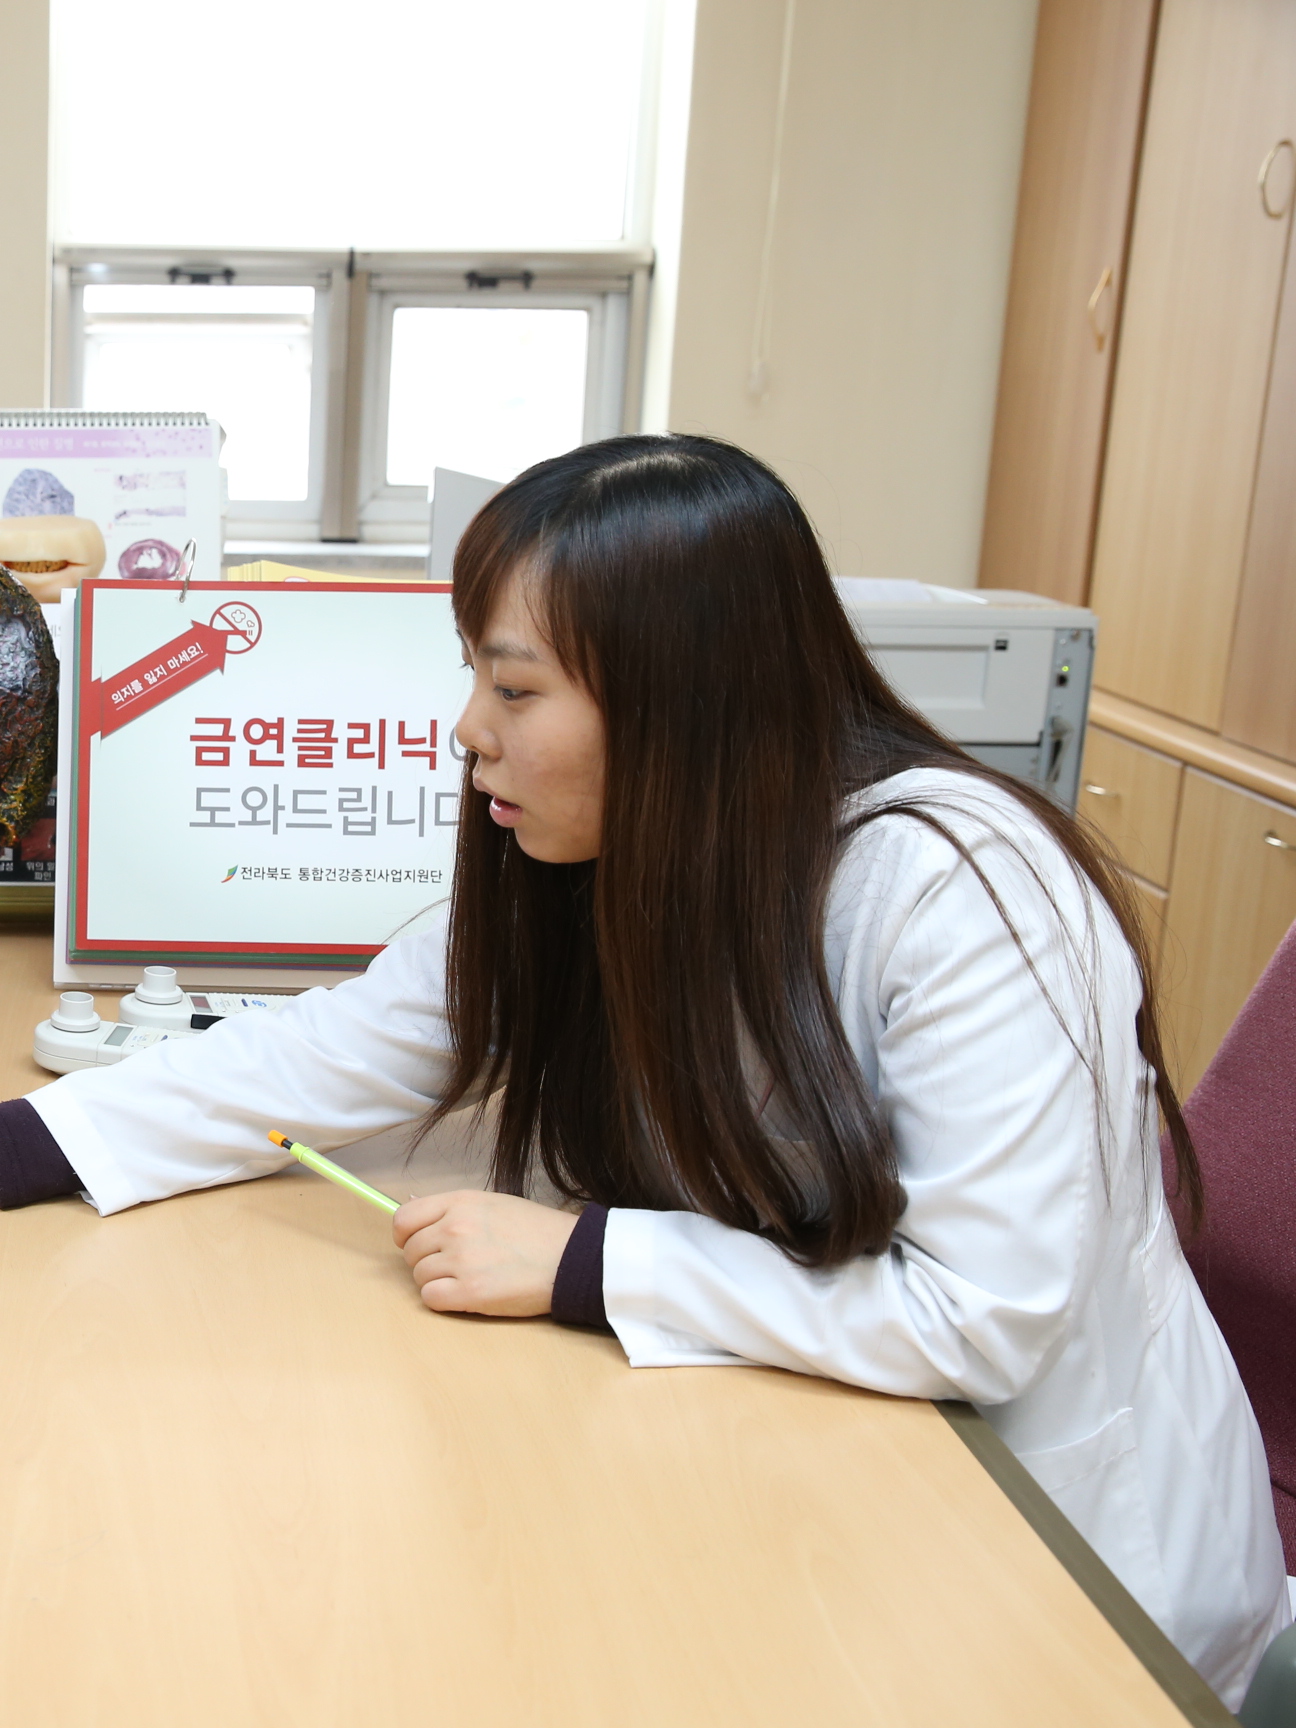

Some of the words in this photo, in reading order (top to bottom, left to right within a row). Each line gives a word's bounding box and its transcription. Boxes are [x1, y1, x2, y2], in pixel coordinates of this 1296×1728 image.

[111, 679, 144, 705] 의지를
[143, 664, 168, 685] 잃지
[167, 641, 204, 670] 마세요!
[240, 866, 293, 881] 전라북도
[298, 866, 443, 884] 통합건강증진사업지원단
